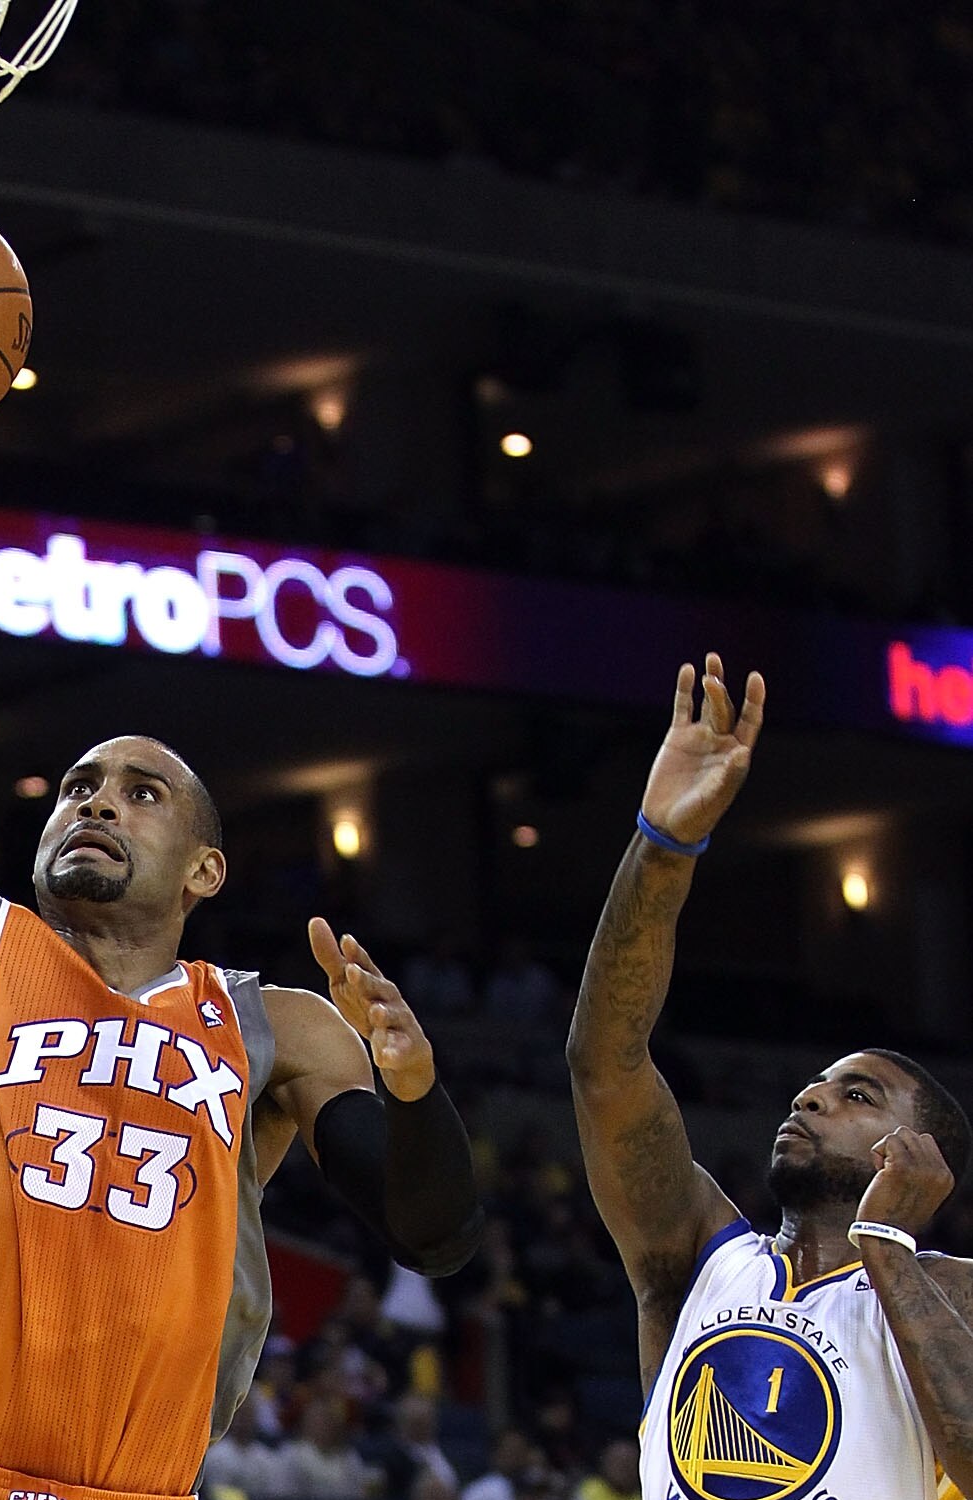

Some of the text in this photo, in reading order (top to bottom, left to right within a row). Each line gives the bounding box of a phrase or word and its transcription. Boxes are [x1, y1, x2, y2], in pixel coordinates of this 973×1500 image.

[20, 1102, 192, 1232] 33
[785, 1312, 849, 1374] STATE
[765, 1367, 785, 1413] 1
